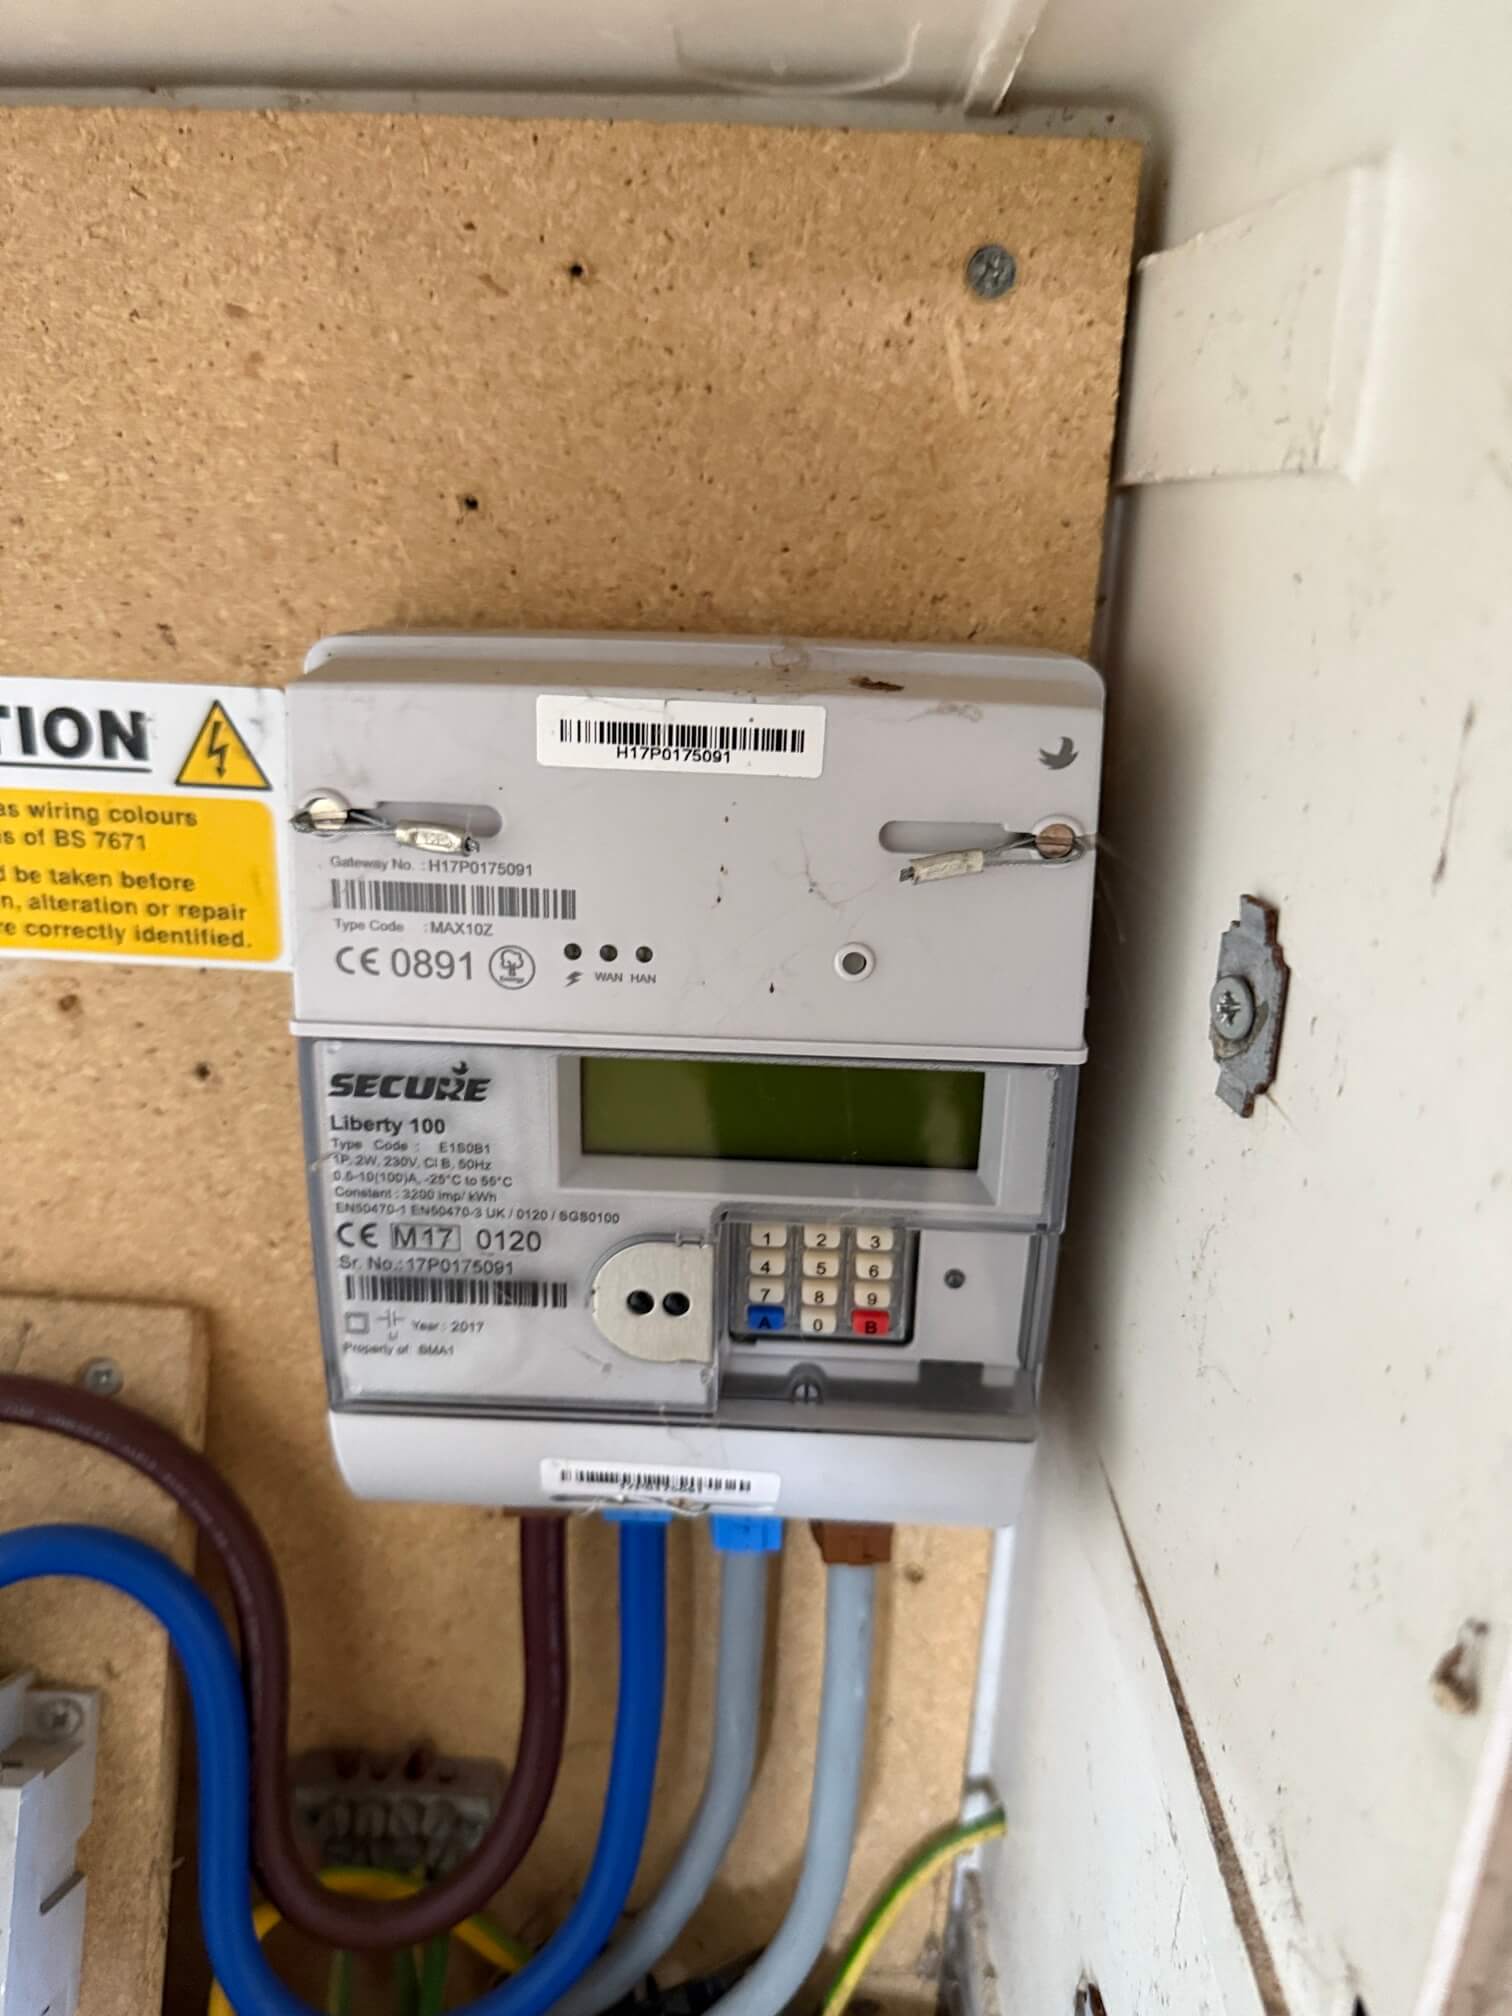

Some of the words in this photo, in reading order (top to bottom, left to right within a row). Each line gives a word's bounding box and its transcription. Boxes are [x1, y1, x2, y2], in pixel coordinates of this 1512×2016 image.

[616, 745, 731, 764] H17P0175091
[28, 801, 100, 826] wiring
[108, 805, 198, 827] colours
[23, 827, 45, 846] of
[54, 829, 87, 849] BS
[95, 831, 147, 851] 7671
[330, 855, 388, 872] Gateway
[14, 865, 42, 884] be
[49, 867, 113, 888] taken
[121, 870, 196, 892] before
[28, 893, 138, 916] alteration
[146, 902, 170, 917] or
[178, 903, 247, 924] repair
[334, 918, 366, 933] Type
[369, 920, 405, 933] Code
[25, 920, 126, 945] correctly
[134, 924, 253, 949] identified.
[390, 947, 473, 981] 0891
[594, 971, 624, 983] WAN
[629, 972, 657, 984] HAN
[328, 1068, 492, 1102] SECURE
[330, 1114, 403, 1137] Liberty
[409, 1118, 446, 1135] 100
[331, 1138, 363, 1151] Type
[373, 1139, 409, 1151] Code
[465, 1174, 478, 1186] to
[335, 1185, 392, 1199] Constant
[402, 1188, 435, 1201] 3200
[486, 1206, 506, 1219] UK
[516, 1208, 548, 1221] 0120
[476, 1228, 542, 1252] 0120
[762, 1232, 771, 1246] 1
[815, 1233, 827, 1247] 2
[870, 1235, 881, 1249] 3
[760, 1260, 770, 1274] 4
[816, 1261, 827, 1275] 5
[868, 1264, 879, 1278] 6
[760, 1288, 770, 1302] 7
[814, 1290, 825, 1304] 8
[867, 1292, 878, 1306] 9
[450, 1320, 485, 1333] 2017
[757, 1316, 771, 1329] A
[813, 1319, 823, 1332] 0
[864, 1320, 877, 1334] B
